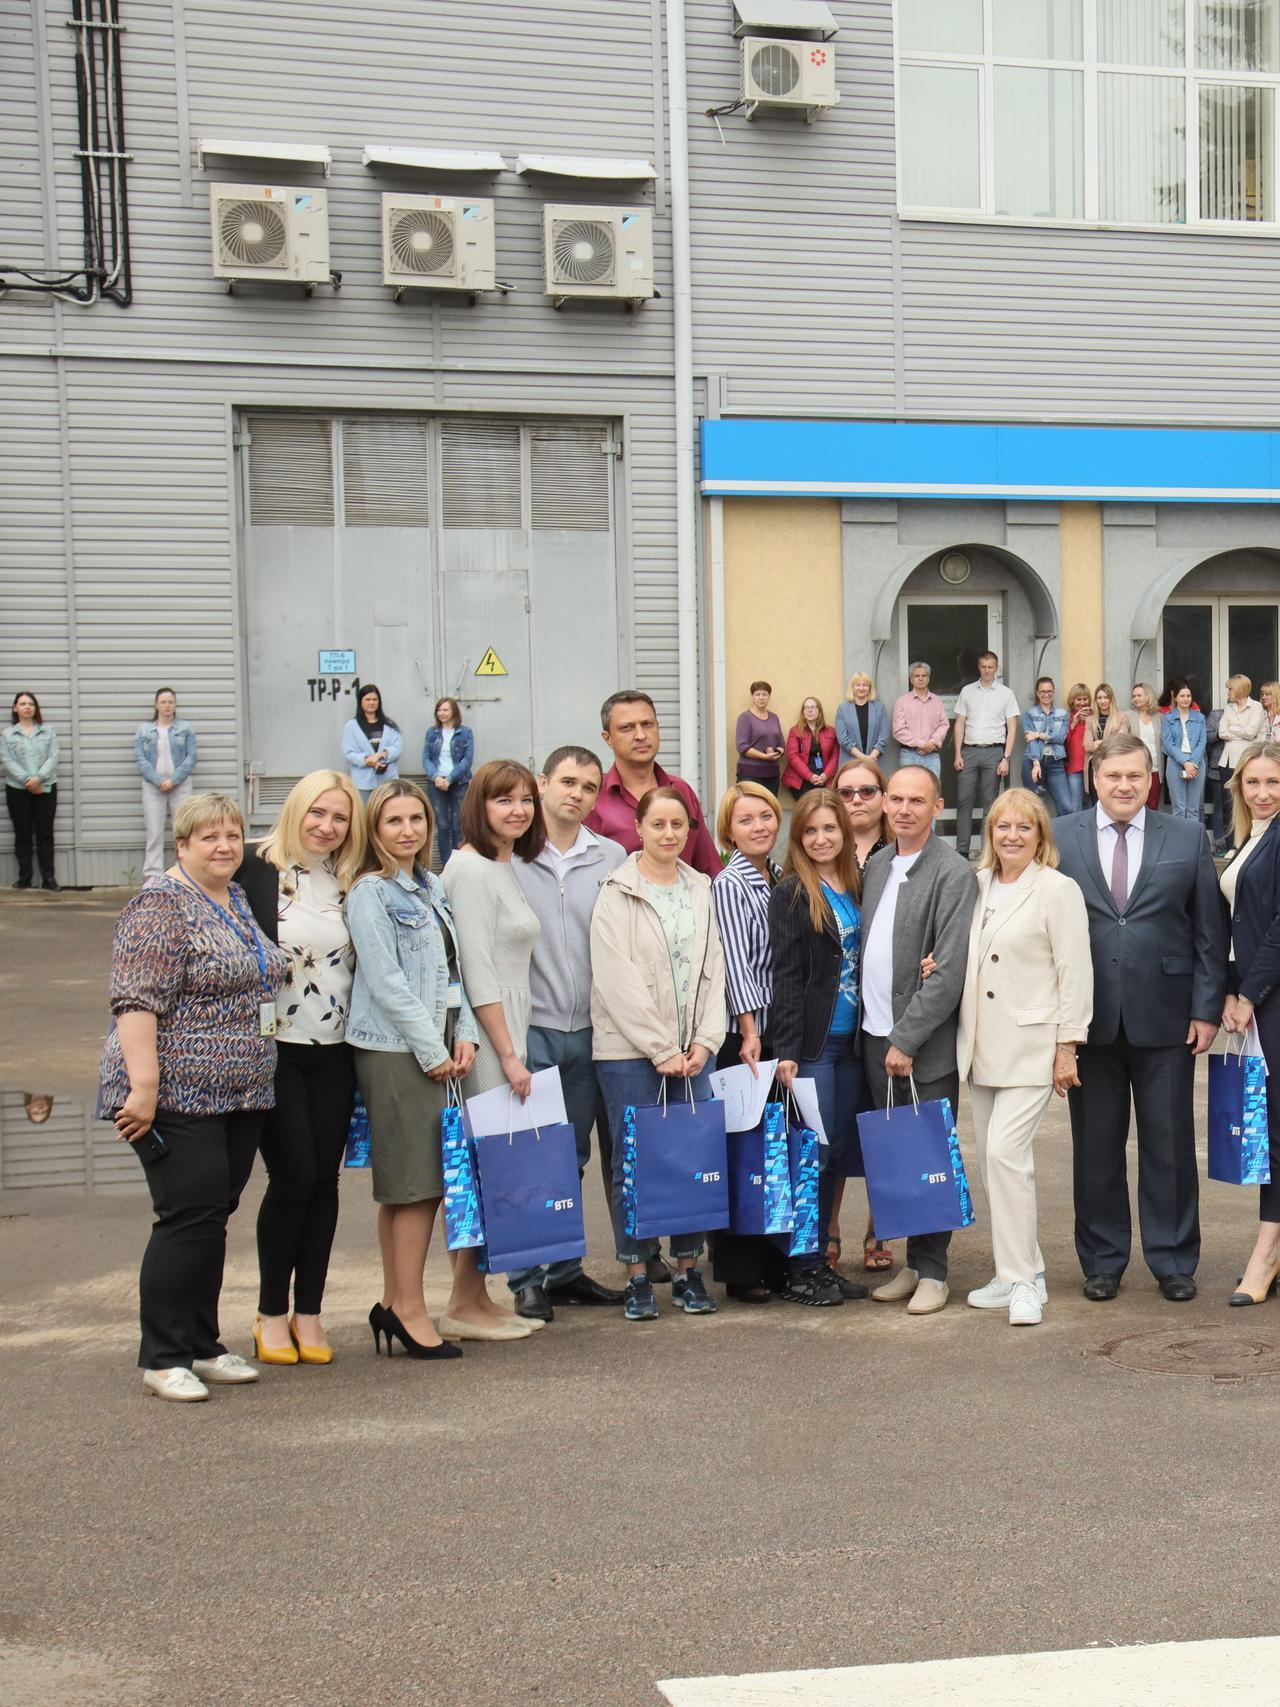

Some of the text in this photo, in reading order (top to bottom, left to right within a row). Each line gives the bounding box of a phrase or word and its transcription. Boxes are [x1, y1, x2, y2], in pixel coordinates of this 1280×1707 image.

[1231, 1126, 1241, 1136] ВТБ
[702, 1171, 720, 1183] ВТБ
[752, 1174, 762, 1185] ВТБ
[929, 1172, 947, 1184] ВТБ
[554, 1198, 574, 1211] ВТБ
